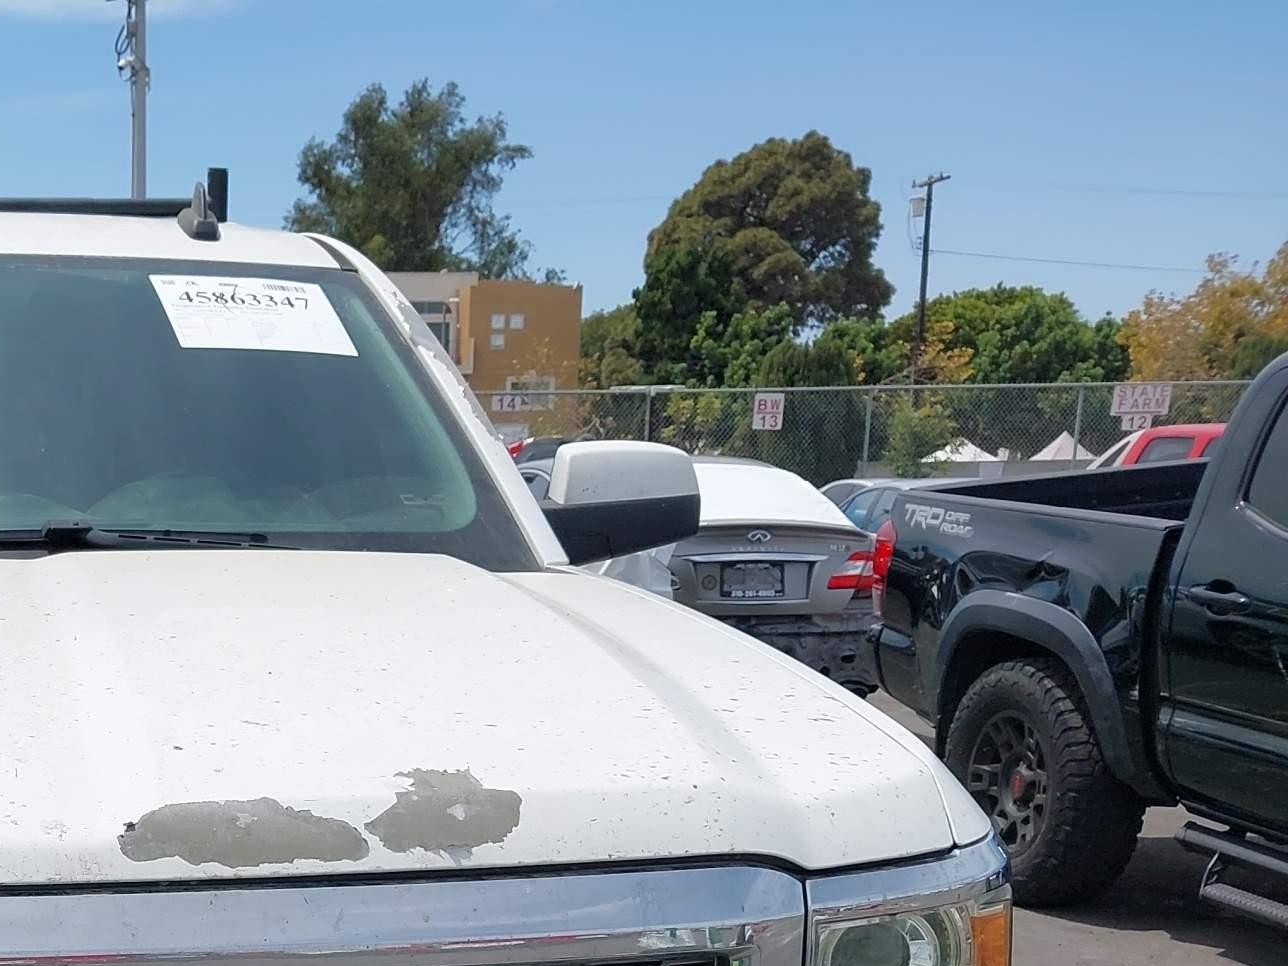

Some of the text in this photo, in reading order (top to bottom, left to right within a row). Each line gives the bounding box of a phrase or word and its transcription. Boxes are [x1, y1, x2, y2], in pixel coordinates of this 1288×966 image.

[179, 289, 309, 310] 45863347
[1118, 384, 1169, 397] STATE
[497, 396, 516, 410] 14
[758, 398, 781, 411] BW
[1118, 398, 1166, 410] FARM
[760, 415, 778, 428] 13
[1128, 415, 1147, 429] 12
[904, 503, 971, 529] TRD OFF
[940, 522, 975, 538] ROAD
